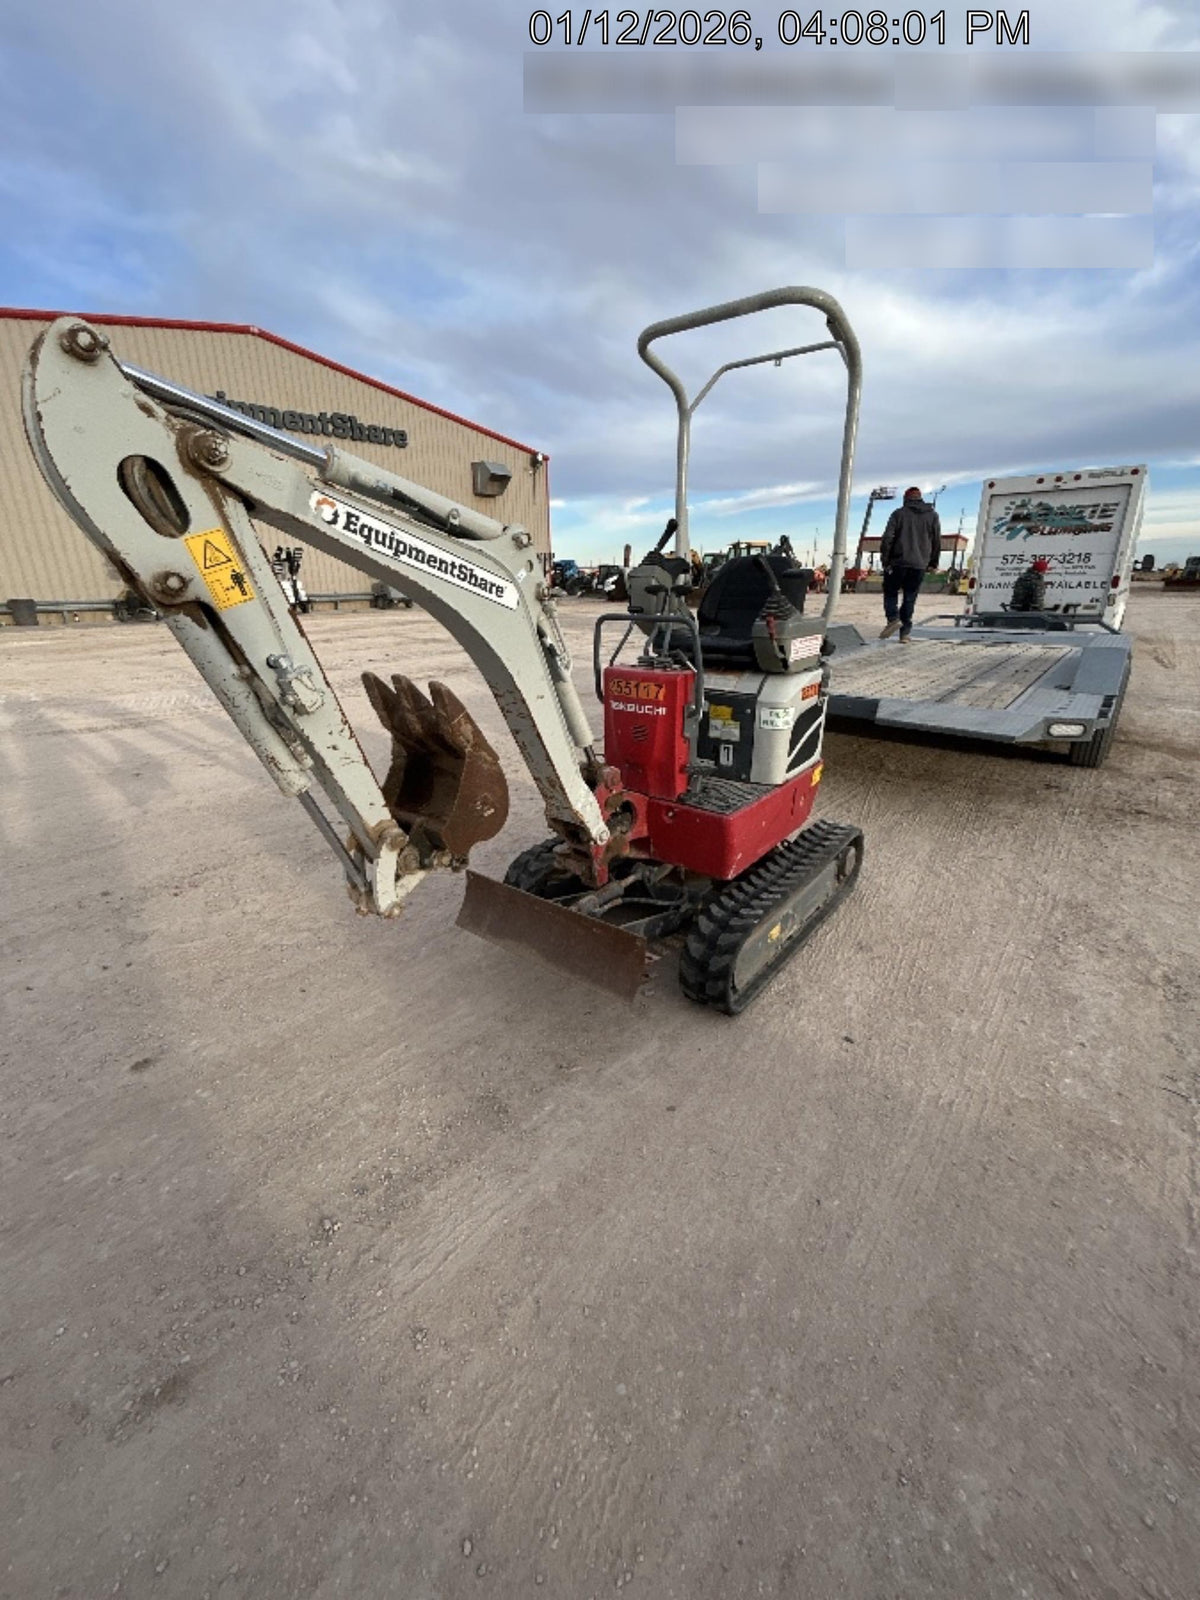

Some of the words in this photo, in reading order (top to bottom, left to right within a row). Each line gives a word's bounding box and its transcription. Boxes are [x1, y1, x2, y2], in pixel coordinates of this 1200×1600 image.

[207, 390, 410, 448] mentShare
[343, 511, 505, 598] EquipmentShare
[1046, 579, 1109, 590] VAILABLE
